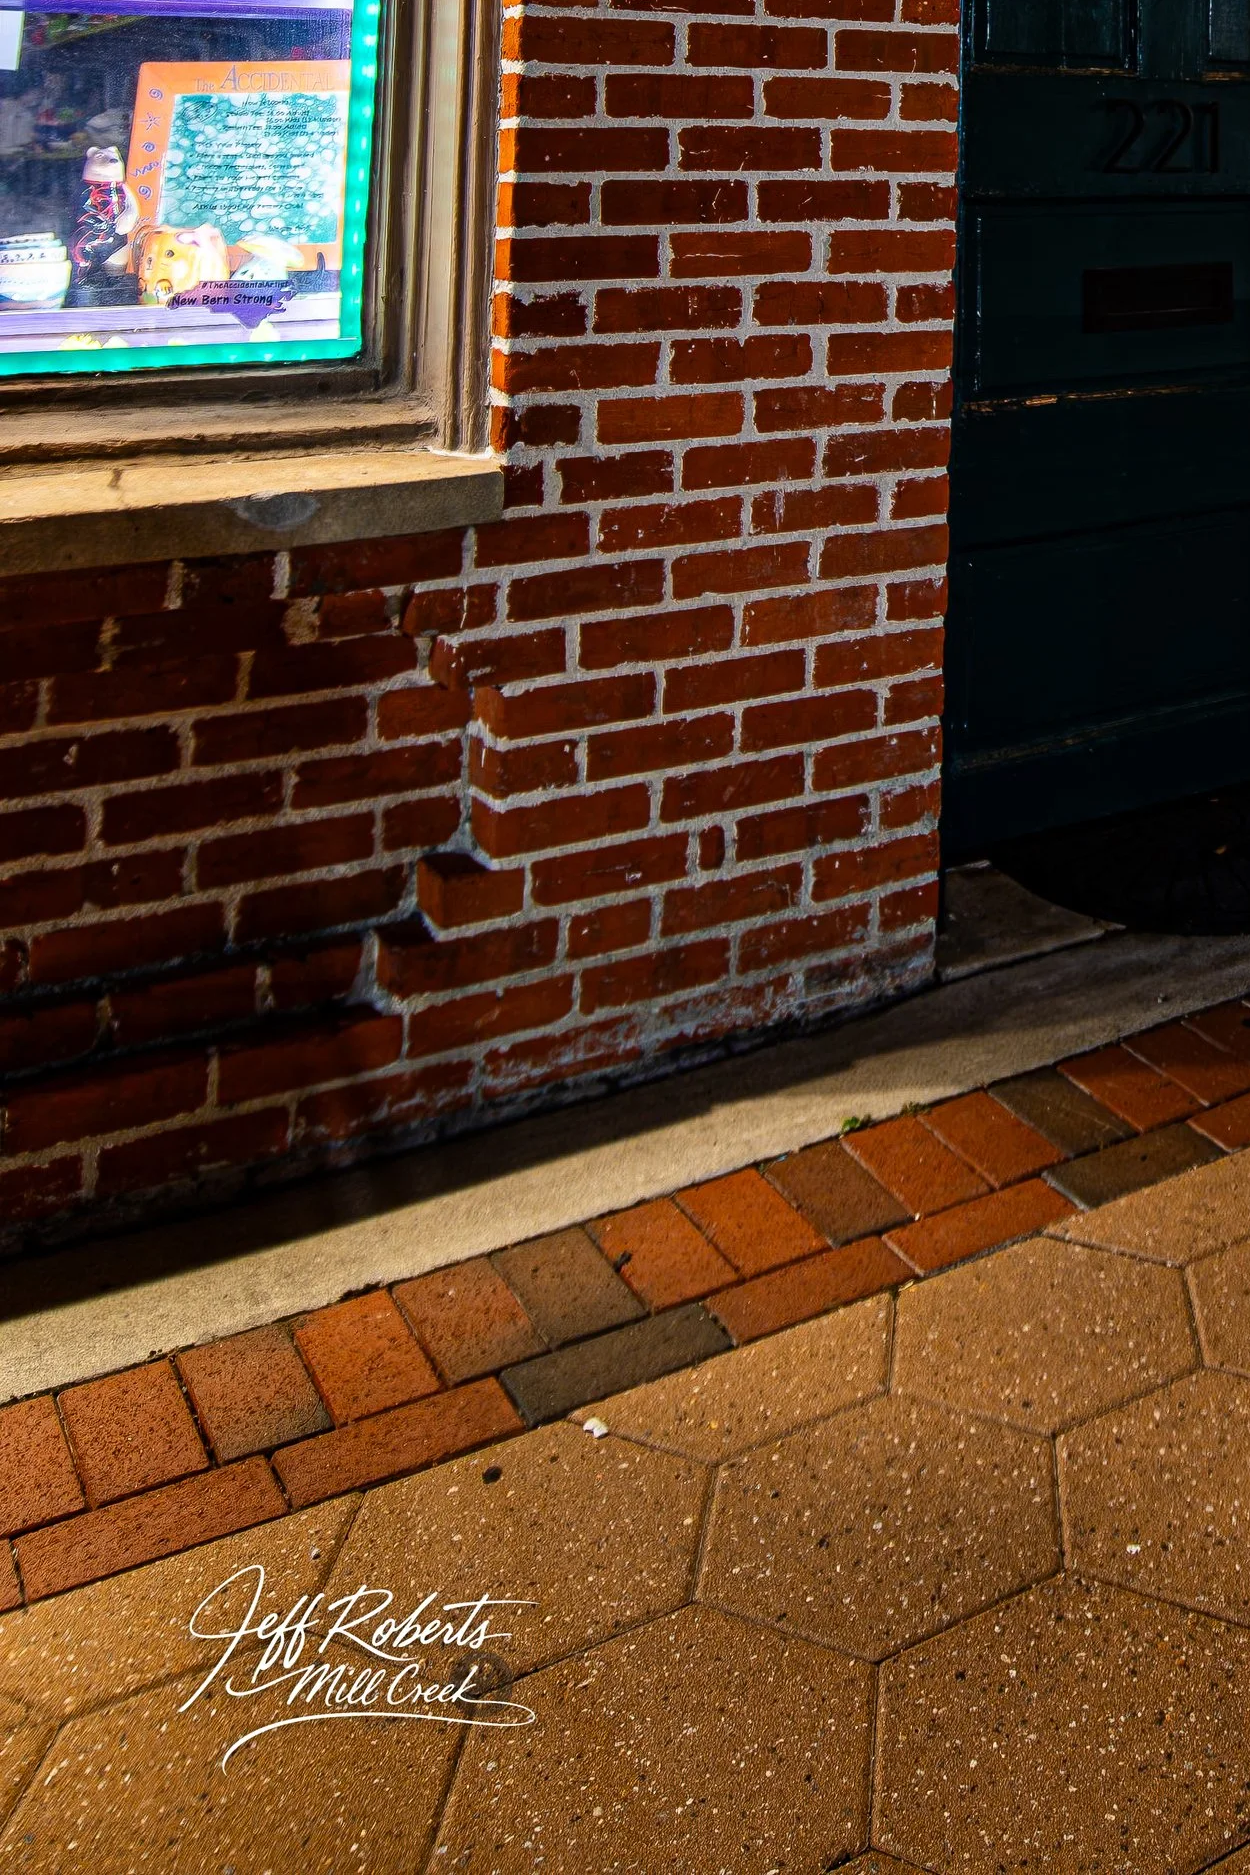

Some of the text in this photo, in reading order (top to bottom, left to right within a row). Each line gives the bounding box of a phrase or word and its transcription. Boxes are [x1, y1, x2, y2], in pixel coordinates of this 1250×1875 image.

[1101, 97, 1220, 174] 221
[171, 292, 273, 306] New Bern Strong
